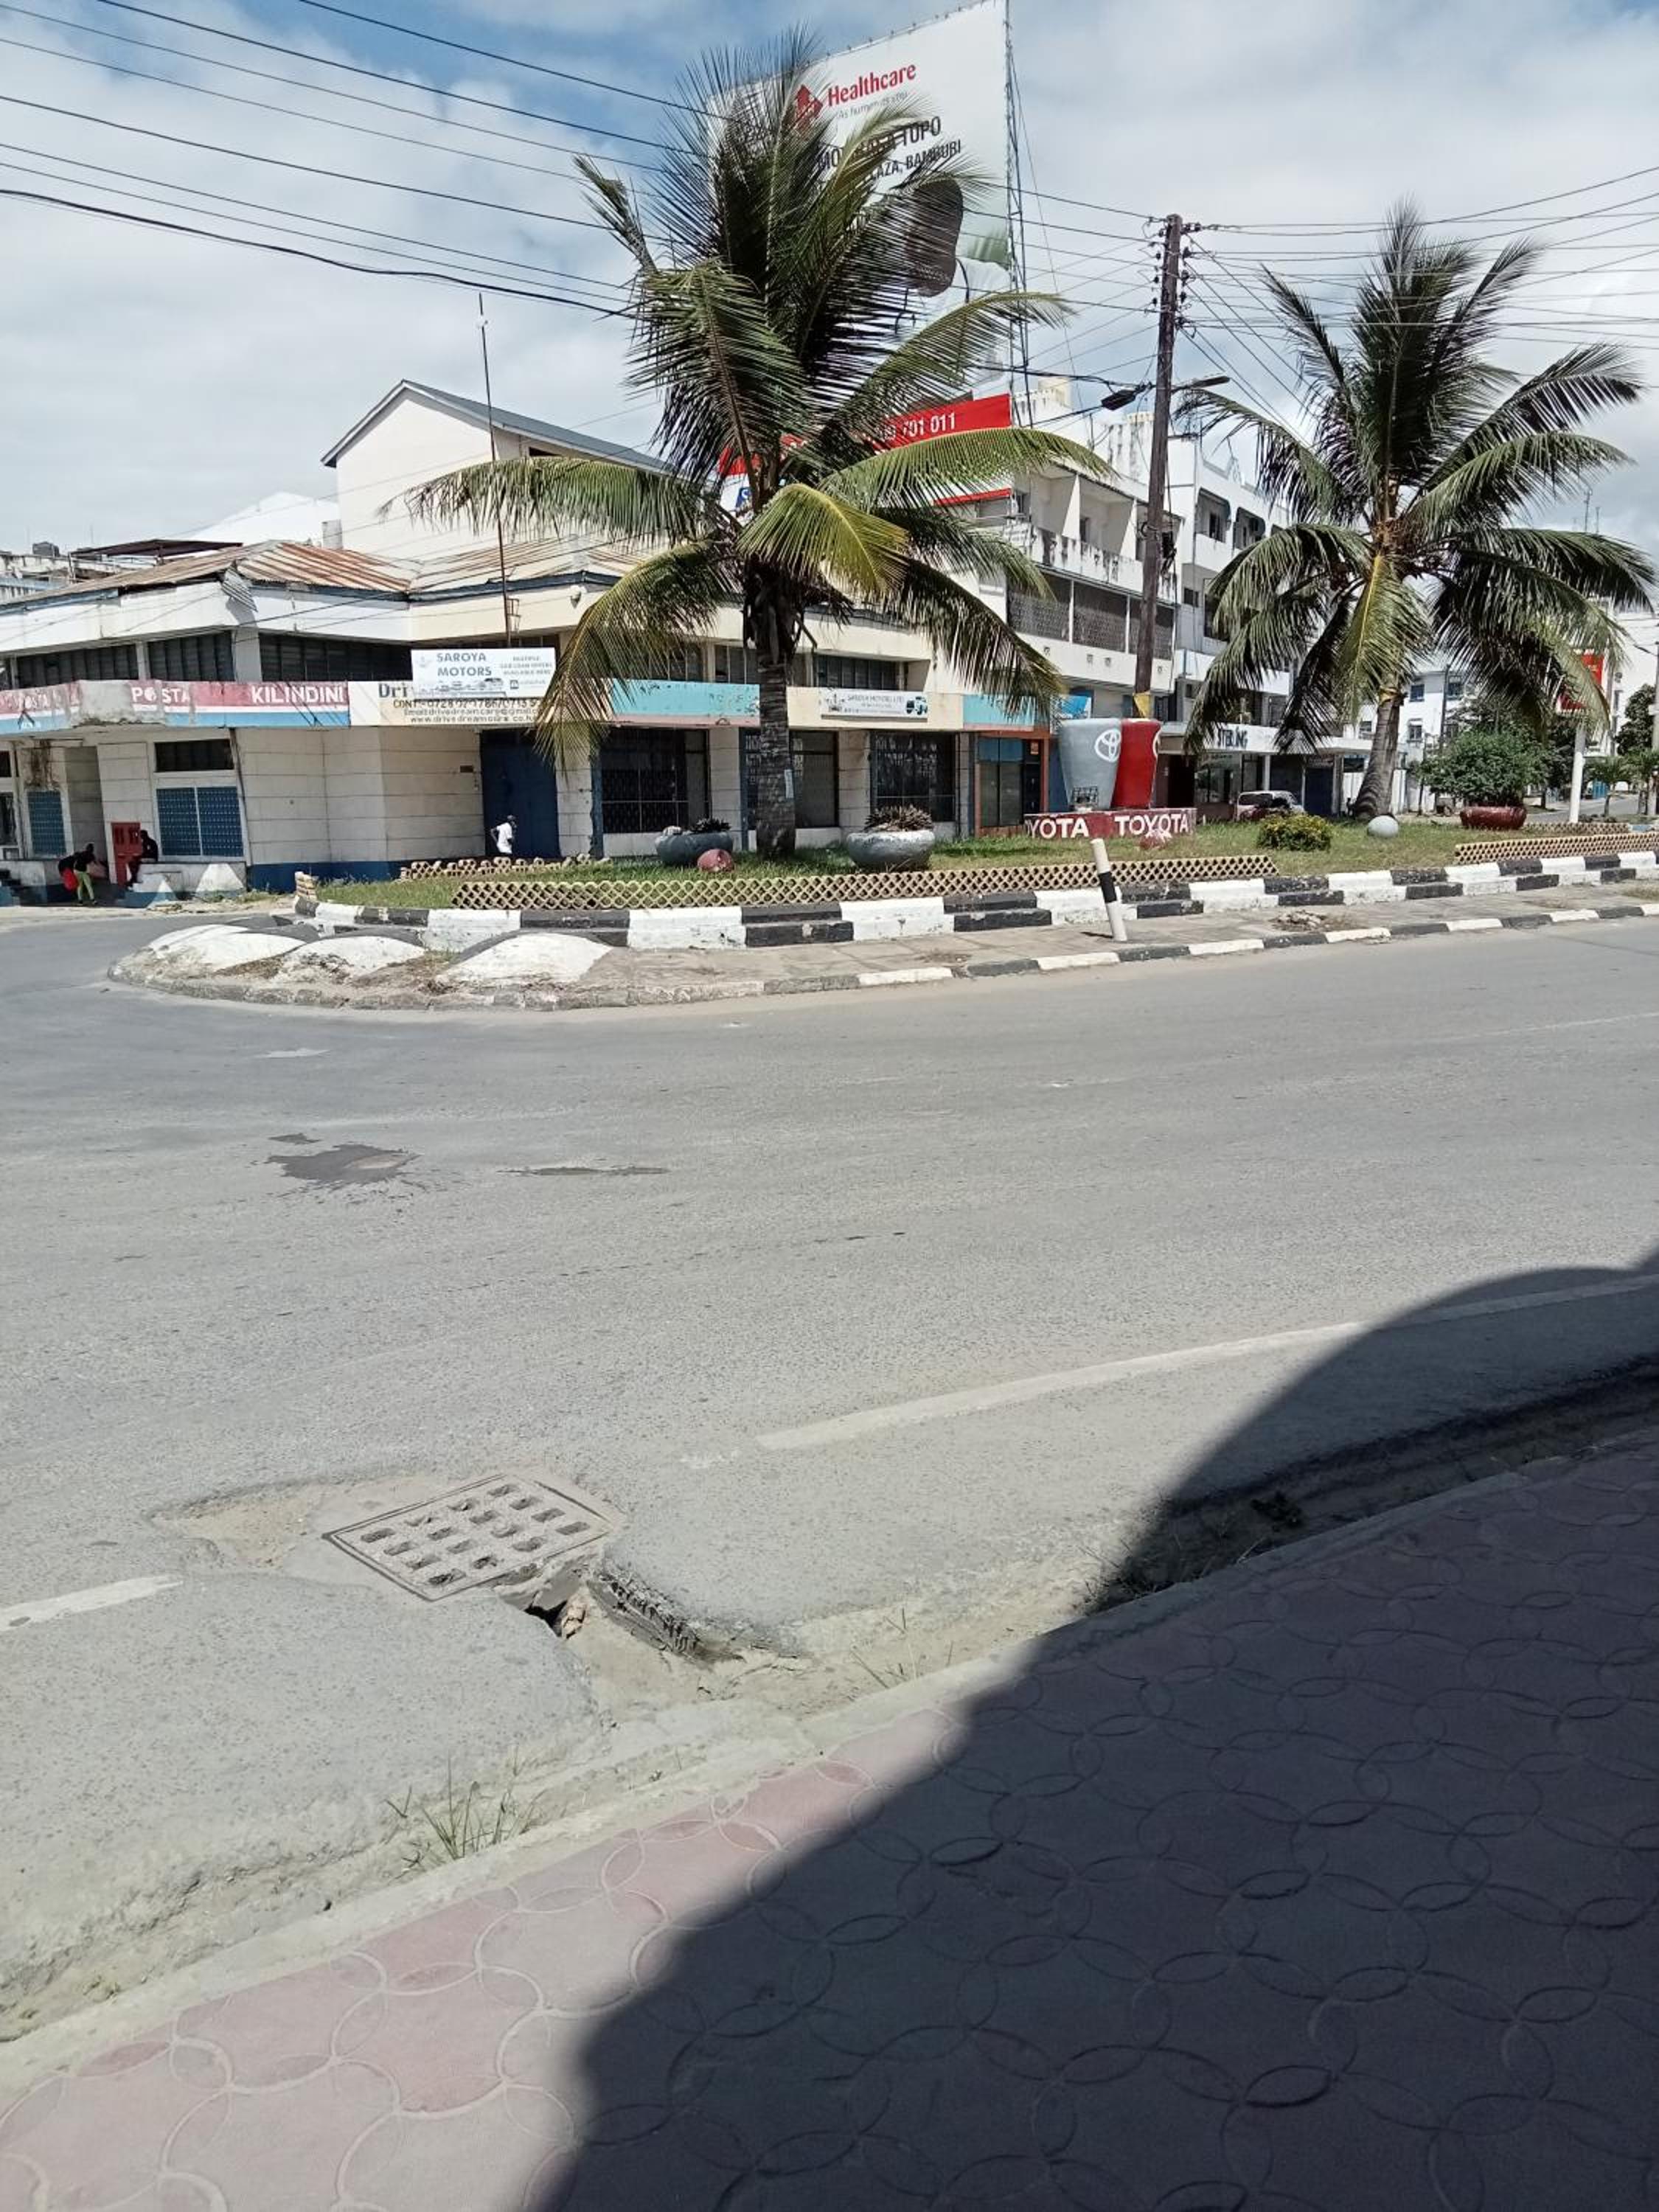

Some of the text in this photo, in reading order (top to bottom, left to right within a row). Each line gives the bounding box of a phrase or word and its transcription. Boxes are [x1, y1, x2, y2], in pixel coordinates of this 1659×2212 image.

[828, 64, 916, 106] Healthcare
[930, 412, 956, 434] 011
[437, 653, 487, 662] SAROYA
[437, 666, 493, 676] MOTORS
[251, 685, 344, 703] KILINDINI
[1114, 813, 1189, 837] TOYOTA
